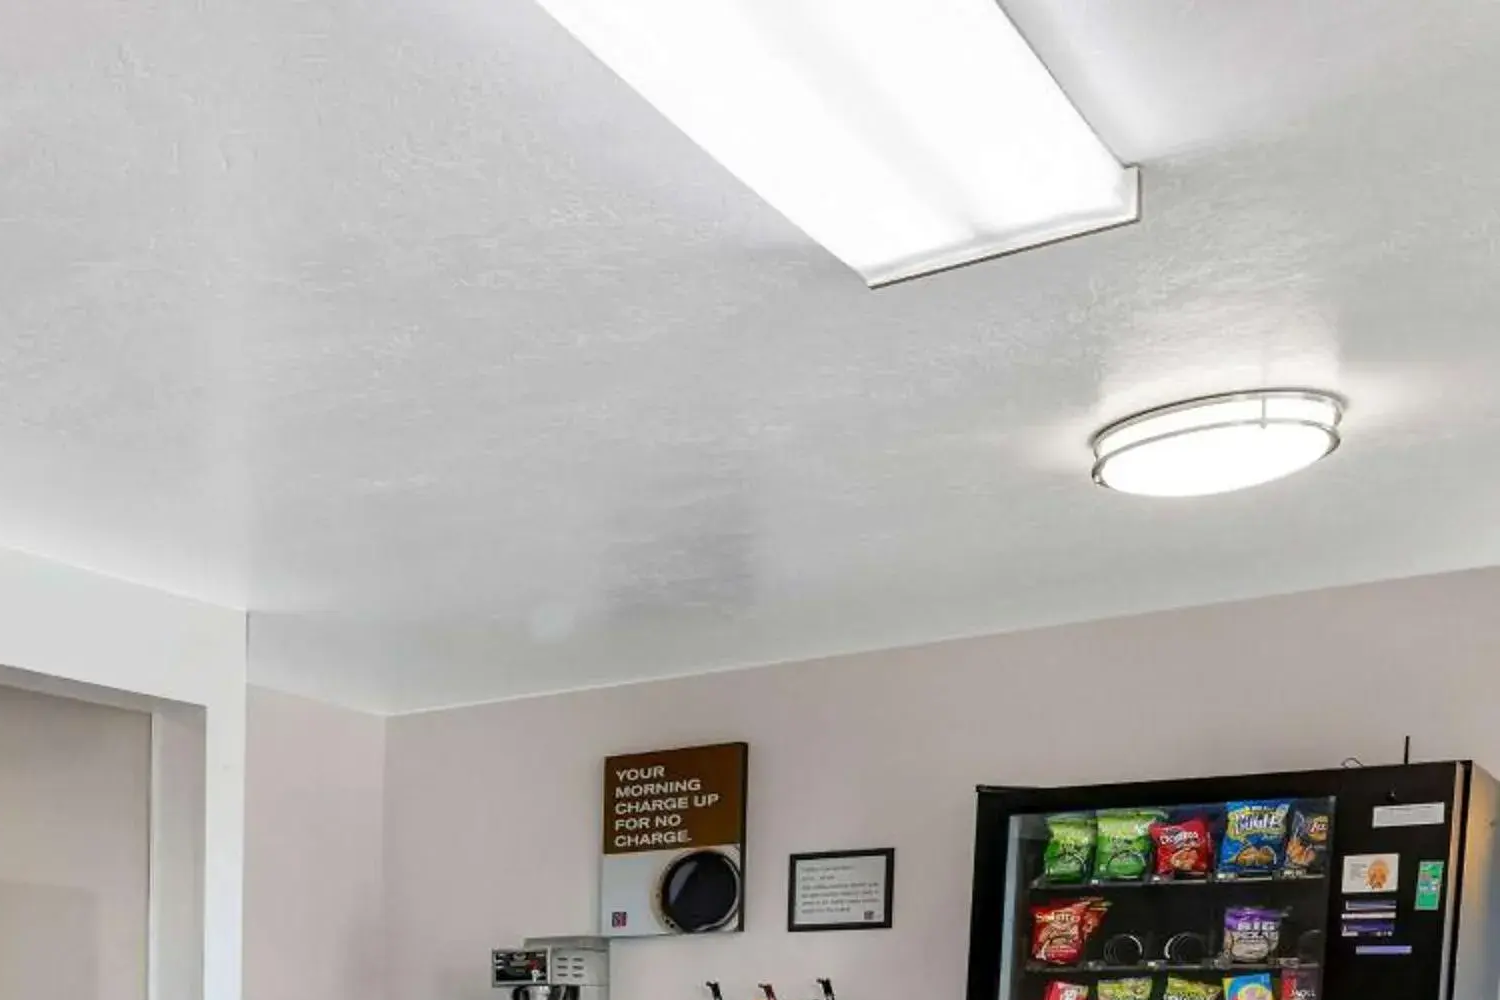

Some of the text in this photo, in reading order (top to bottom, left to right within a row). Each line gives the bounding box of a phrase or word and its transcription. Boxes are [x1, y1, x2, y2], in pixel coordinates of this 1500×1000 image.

[615, 765, 665, 781] YOUR
[615, 779, 701, 798] MORNING
[615, 793, 719, 815] CHARGE UP
[615, 814, 682, 831] FOR NO
[614, 829, 692, 847] CHARGE.
